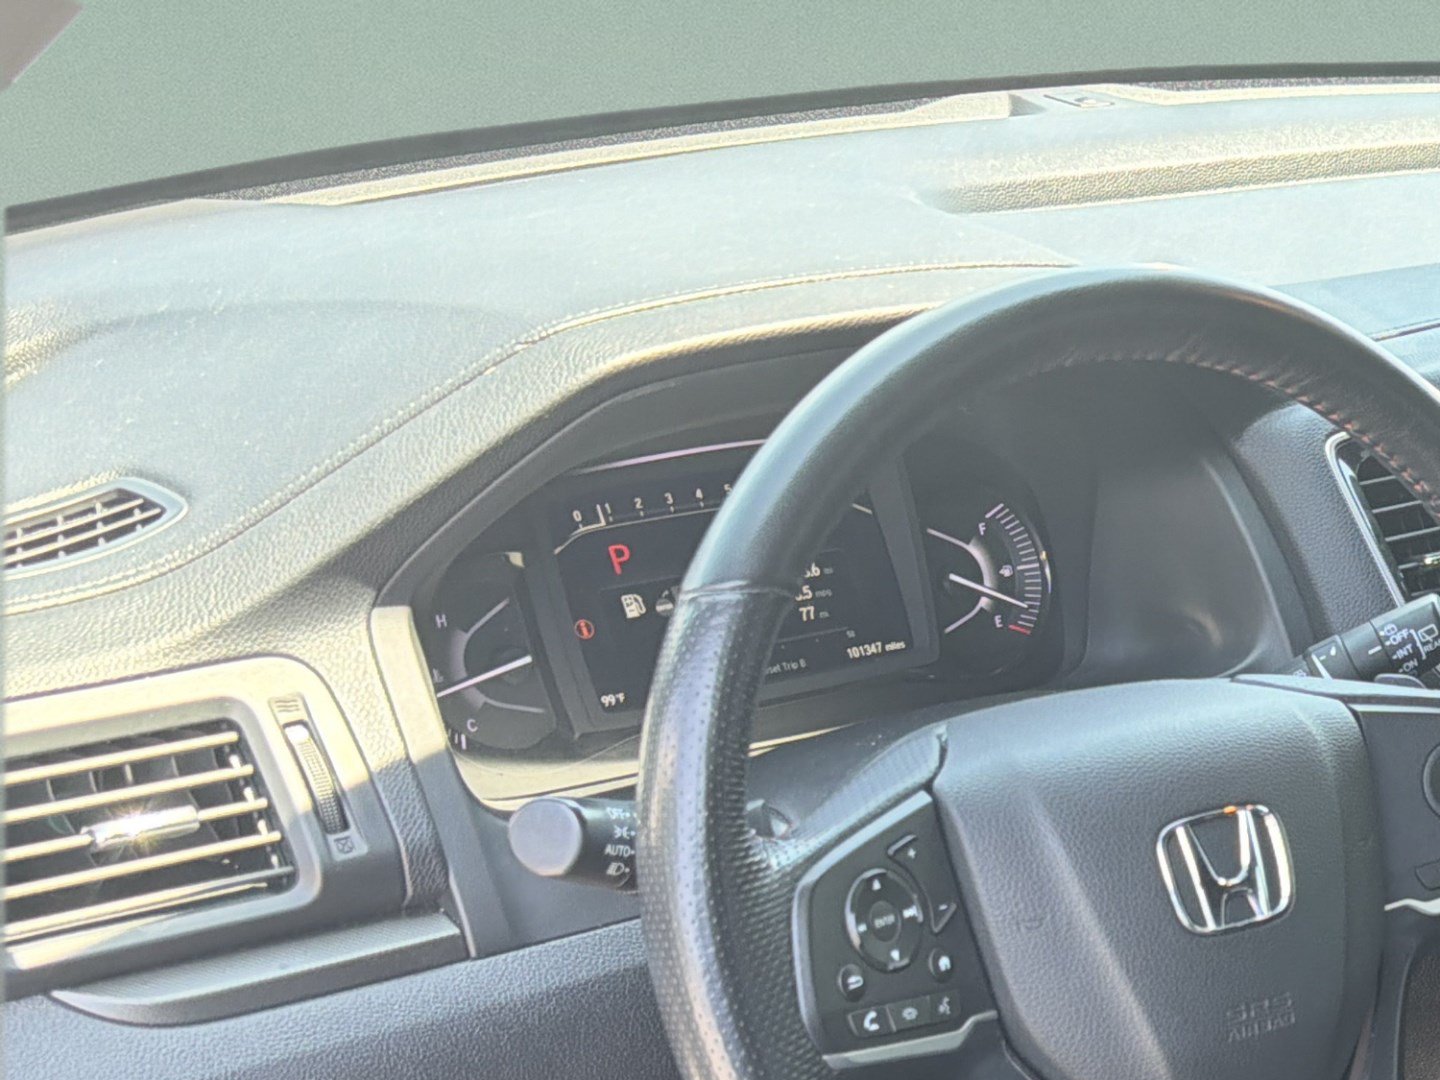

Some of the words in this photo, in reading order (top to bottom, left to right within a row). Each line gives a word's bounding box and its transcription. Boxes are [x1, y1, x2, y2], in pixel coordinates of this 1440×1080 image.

[664, 492, 674, 504] 3
[695, 488, 703, 499] 4
[604, 502, 612, 514] 1
[634, 498, 644, 509] 2
[572, 510, 583, 522] 0
[978, 522, 986, 535] F
[608, 544, 630, 575] P
[799, 606, 815, 621] 77
[435, 614, 447, 628] H
[994, 615, 1003, 628] E
[1389, 628, 1410, 646] OFF
[846, 642, 882, 659] 101347
[885, 641, 906, 652] miles
[1402, 658, 1419, 673] ON
[466, 719, 478, 732] C
[604, 843, 631, 857] AUTO
